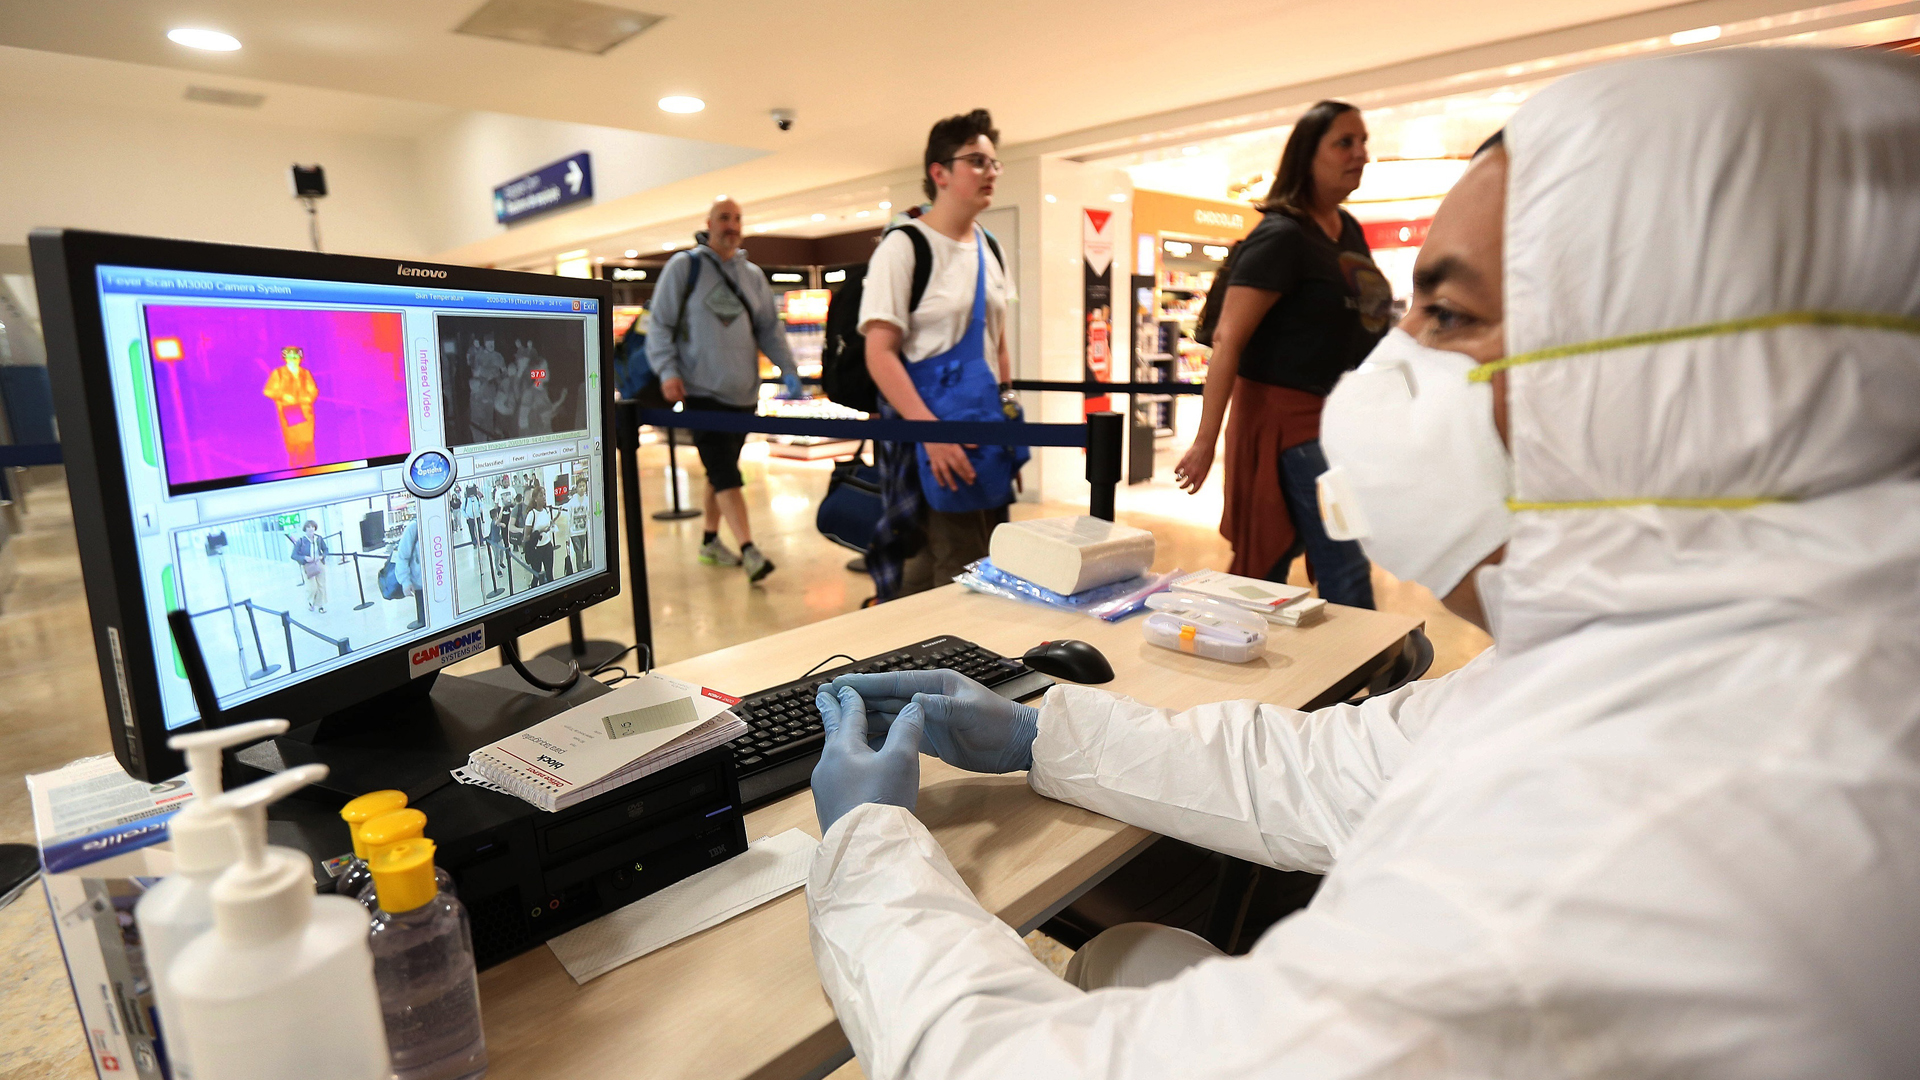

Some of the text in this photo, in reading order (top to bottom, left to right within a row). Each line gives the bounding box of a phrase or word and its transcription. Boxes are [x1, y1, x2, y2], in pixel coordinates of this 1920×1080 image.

[397, 264, 448, 279] lenovo
[146, 277, 175, 289] Scan
[177, 279, 214, 291] M3000
[216, 281, 256, 293] Camera
[257, 283, 292, 295] System
[429, 293, 464, 302] Temperature
[583, 301, 595, 311] Exit
[420, 349, 431, 418] Infrared Video
[595, 441, 600, 451] 2
[475, 459, 504, 469] Unclassified
[532, 449, 558, 458] Countercheck
[417, 467, 442, 476] Options
[144, 513, 151, 527] 1
[433, 535, 444, 586] CCD Video
[412, 629, 482, 666] CANTRONIC
[441, 647, 471, 664] SYSTEMS
[549, 745, 568, 754] para
[536, 754, 565, 770] block
[544, 776, 564, 788] Office
[82, 820, 172, 850] icrolife
[708, 843, 727, 858] IBM
